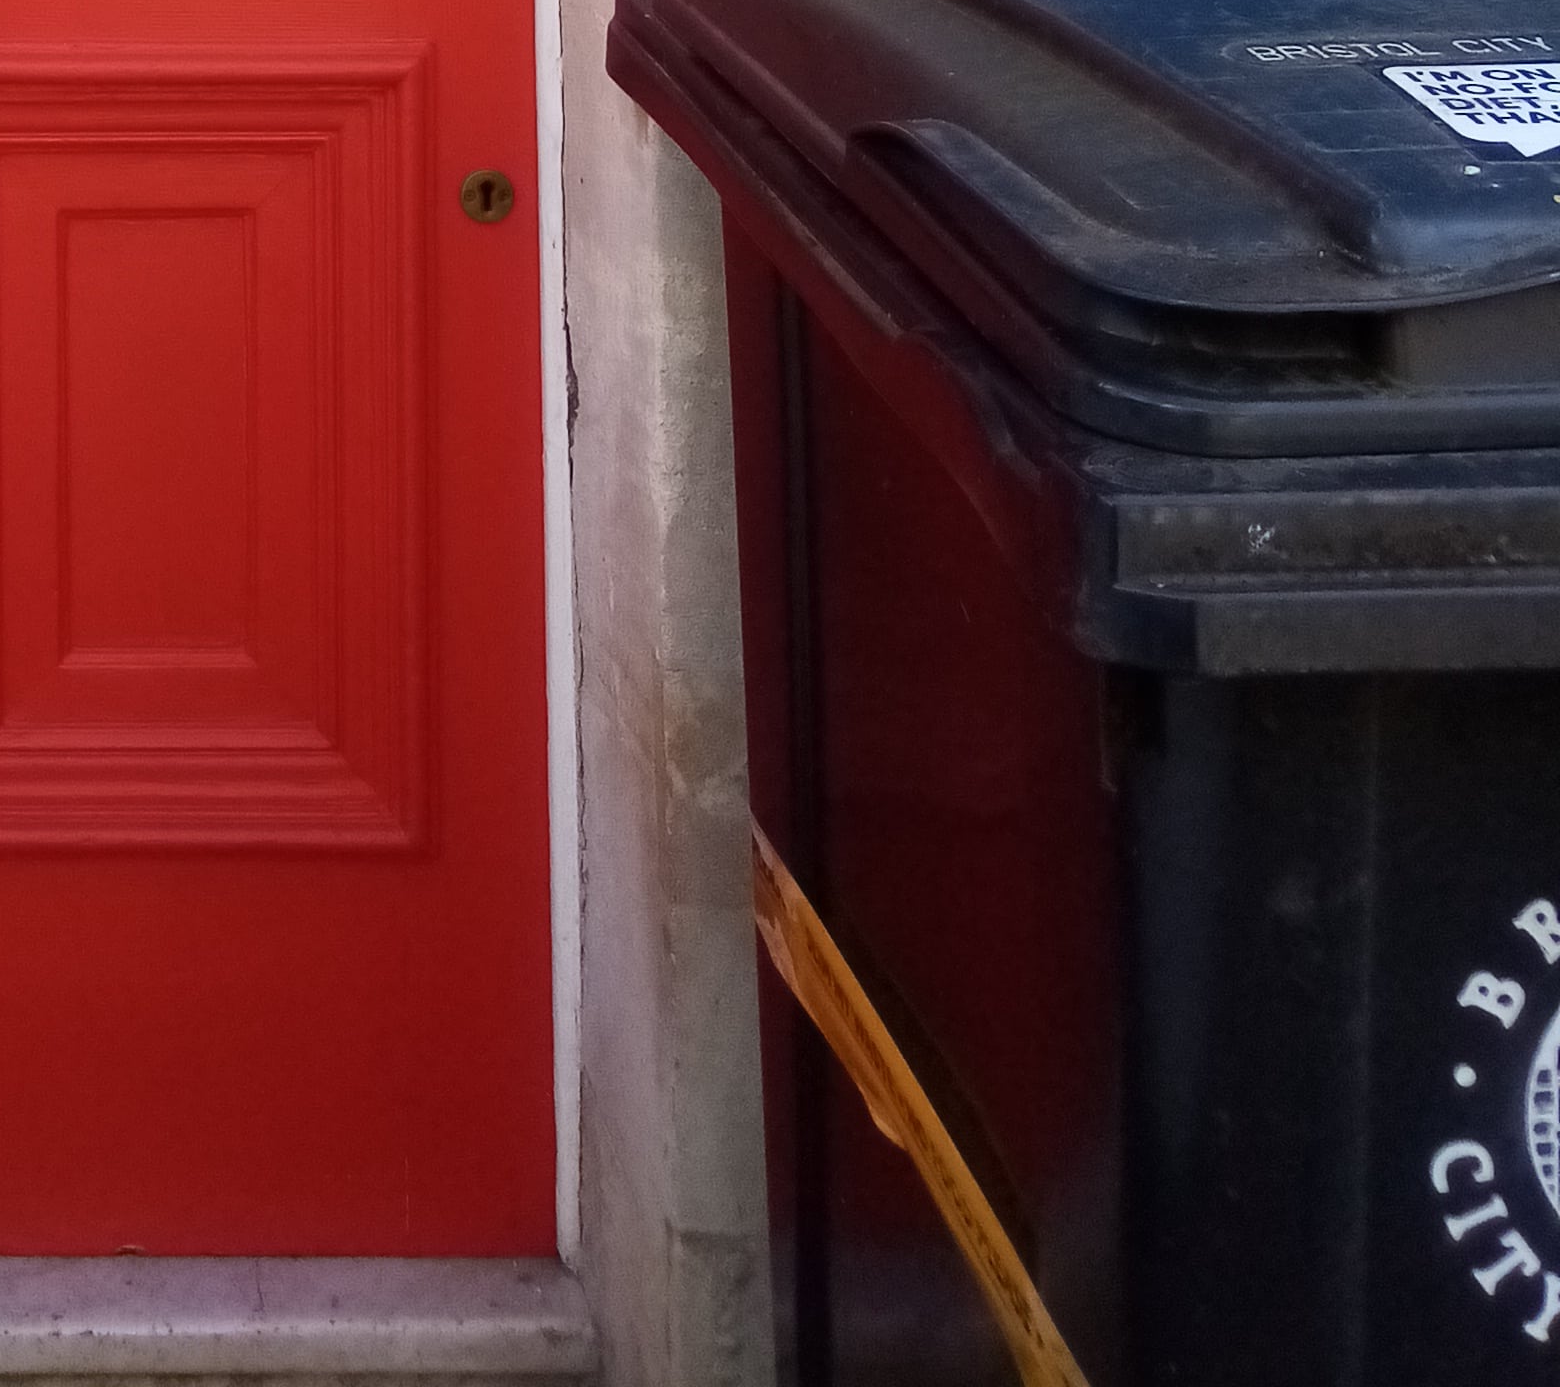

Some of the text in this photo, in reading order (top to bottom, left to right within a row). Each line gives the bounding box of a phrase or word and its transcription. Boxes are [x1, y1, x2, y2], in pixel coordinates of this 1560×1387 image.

[1246, 36, 1553, 62] BRISTOL CITY
[1402, 68, 1557, 82] I'M ON
[1454, 111, 1560, 125] THA
